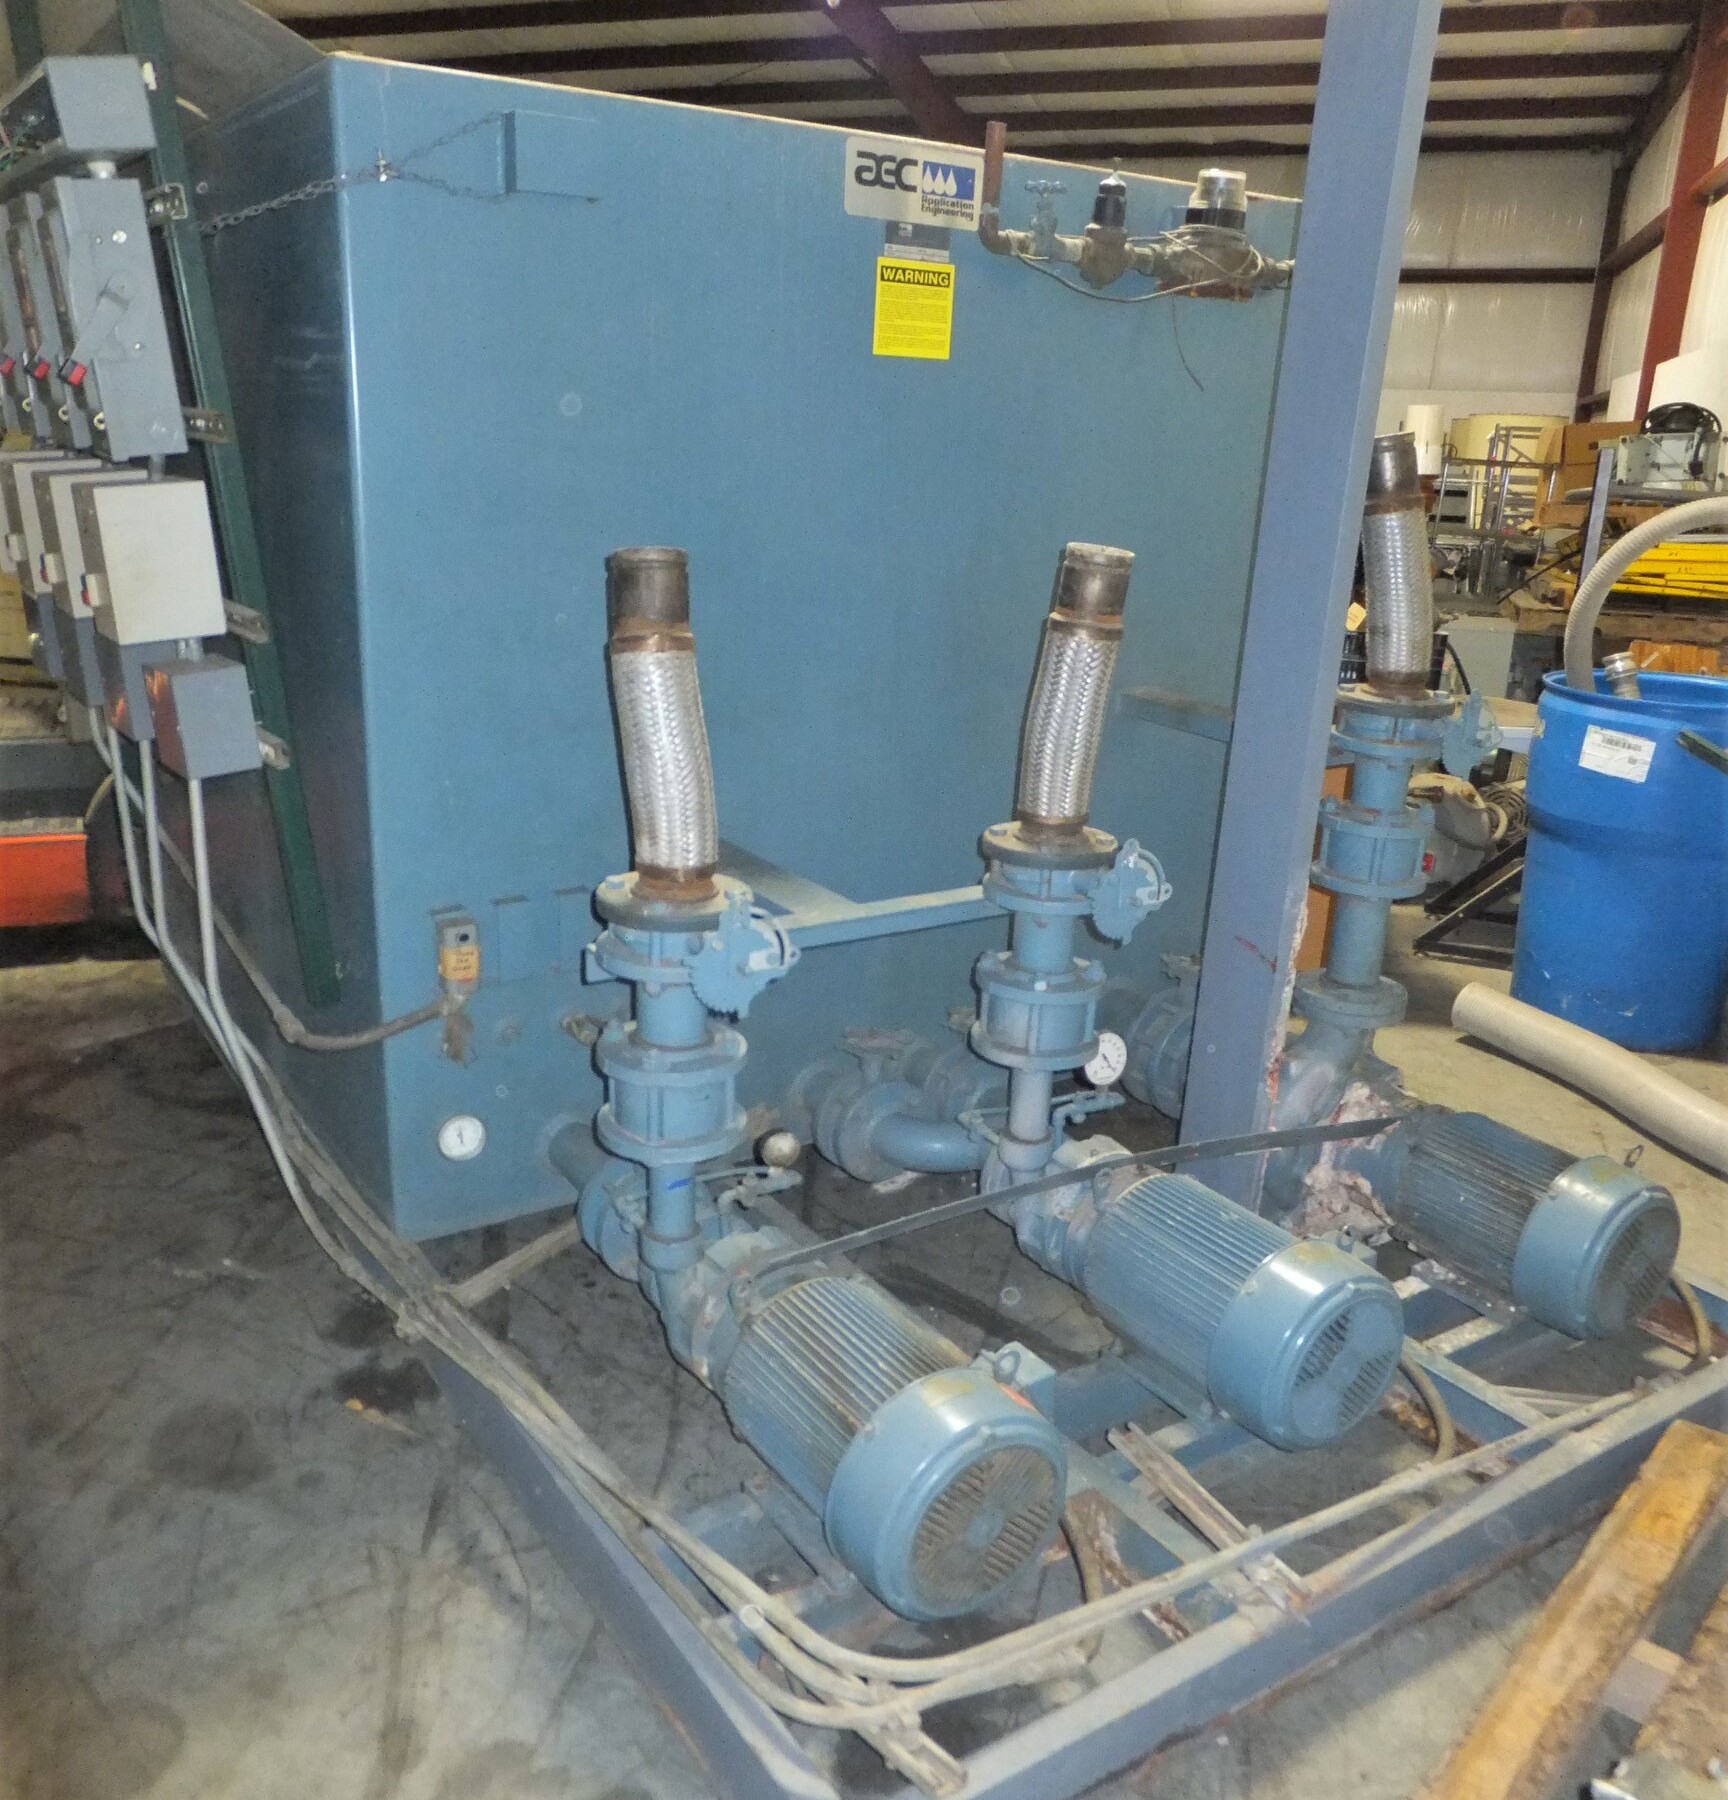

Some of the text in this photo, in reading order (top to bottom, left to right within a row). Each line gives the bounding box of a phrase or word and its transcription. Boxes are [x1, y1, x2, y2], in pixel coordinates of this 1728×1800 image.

[921, 194, 974, 210] Application
[921, 204, 974, 221] Engineering
[881, 266, 949, 286] WARNING
